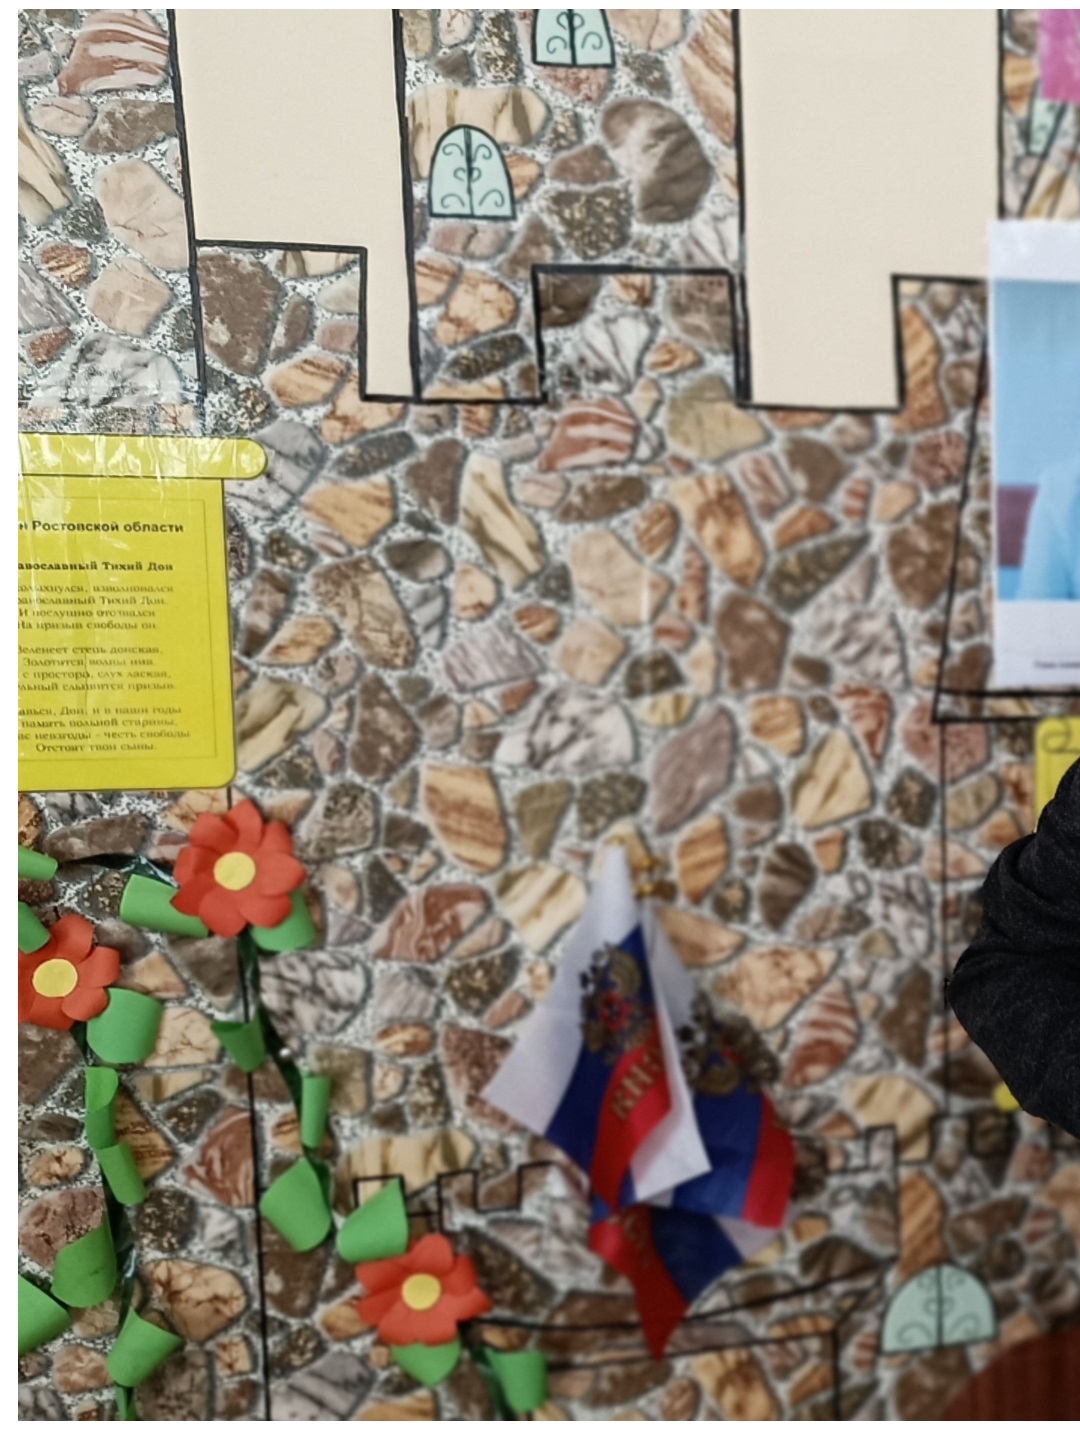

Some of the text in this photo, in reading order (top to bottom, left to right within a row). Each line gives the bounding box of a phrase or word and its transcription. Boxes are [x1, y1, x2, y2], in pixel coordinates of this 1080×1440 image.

[32, 521, 119, 533] Ростовской
[124, 522, 183, 532] области
[102, 561, 143, 570] Тихий
[147, 562, 173, 571] Дон
[100, 596, 137, 605] Тихий
